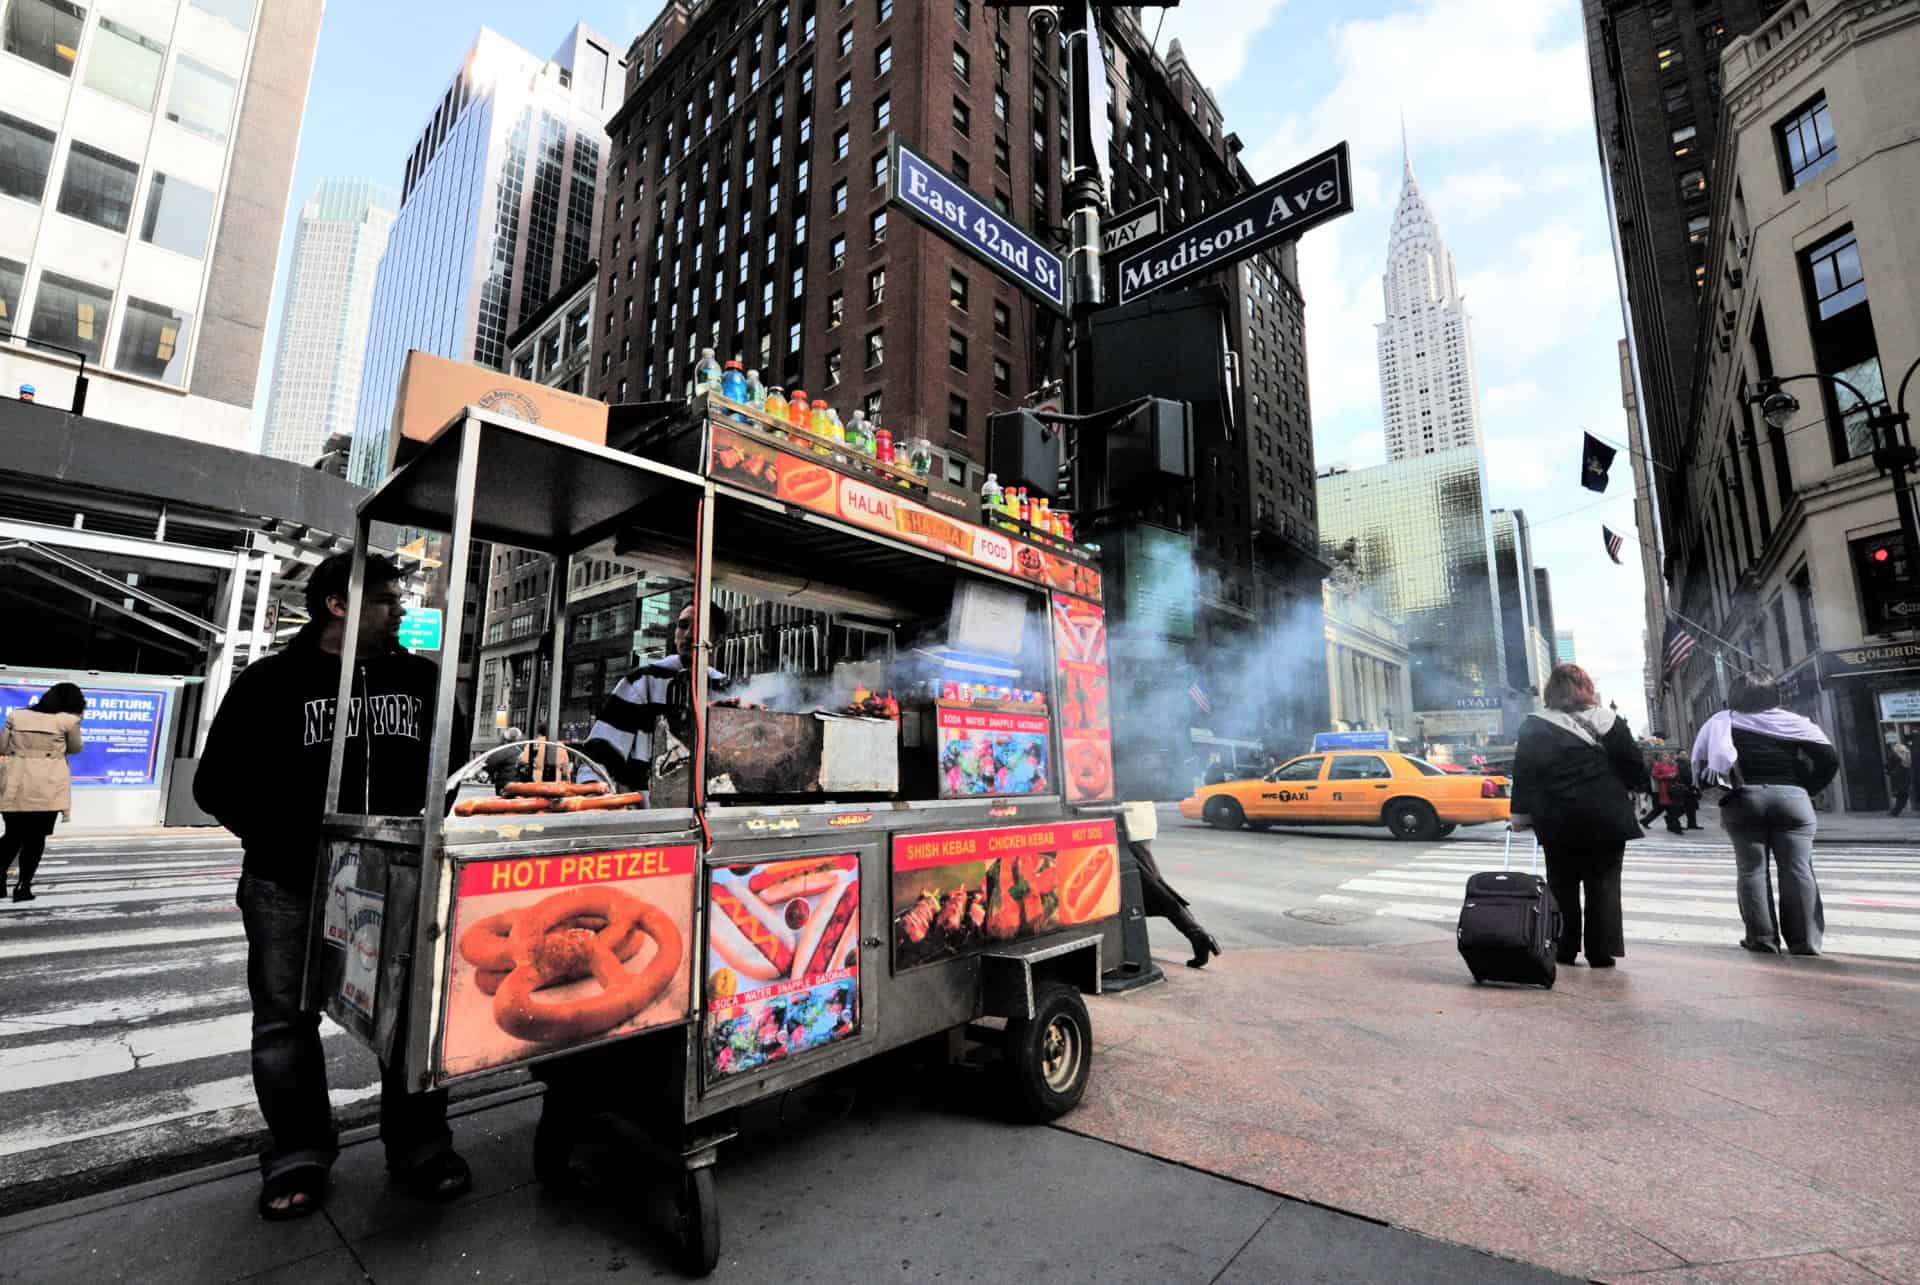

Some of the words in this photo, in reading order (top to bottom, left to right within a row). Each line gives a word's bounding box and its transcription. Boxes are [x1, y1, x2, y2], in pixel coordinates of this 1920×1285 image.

[908, 165, 968, 231] East
[973, 217, 1030, 273] 42nd
[1034, 258, 1058, 292] St
[1103, 220, 1141, 252] WAY
[1122, 217, 1256, 295] Madison
[1265, 176, 1337, 230] Ave
[848, 490, 892, 521] HALAL
[980, 538, 1008, 560] FOOD
[82, 709, 153, 722] EPARTURE.
[100, 699, 155, 710] RETURN.
[1456, 697, 1499, 709] HYATT
[304, 697, 362, 746] NEW
[369, 693, 423, 742] YORK
[906, 844, 940, 861] SHISH
[941, 839, 977, 857] KEBAB
[988, 835, 1026, 851] CHICKEN
[1027, 831, 1056, 847] KEBAB
[491, 860, 552, 889] HOT
[560, 850, 671, 883] PRETZEL
[745, 988, 772, 1003] WATER
[777, 977, 811, 994] SNAPPLE
